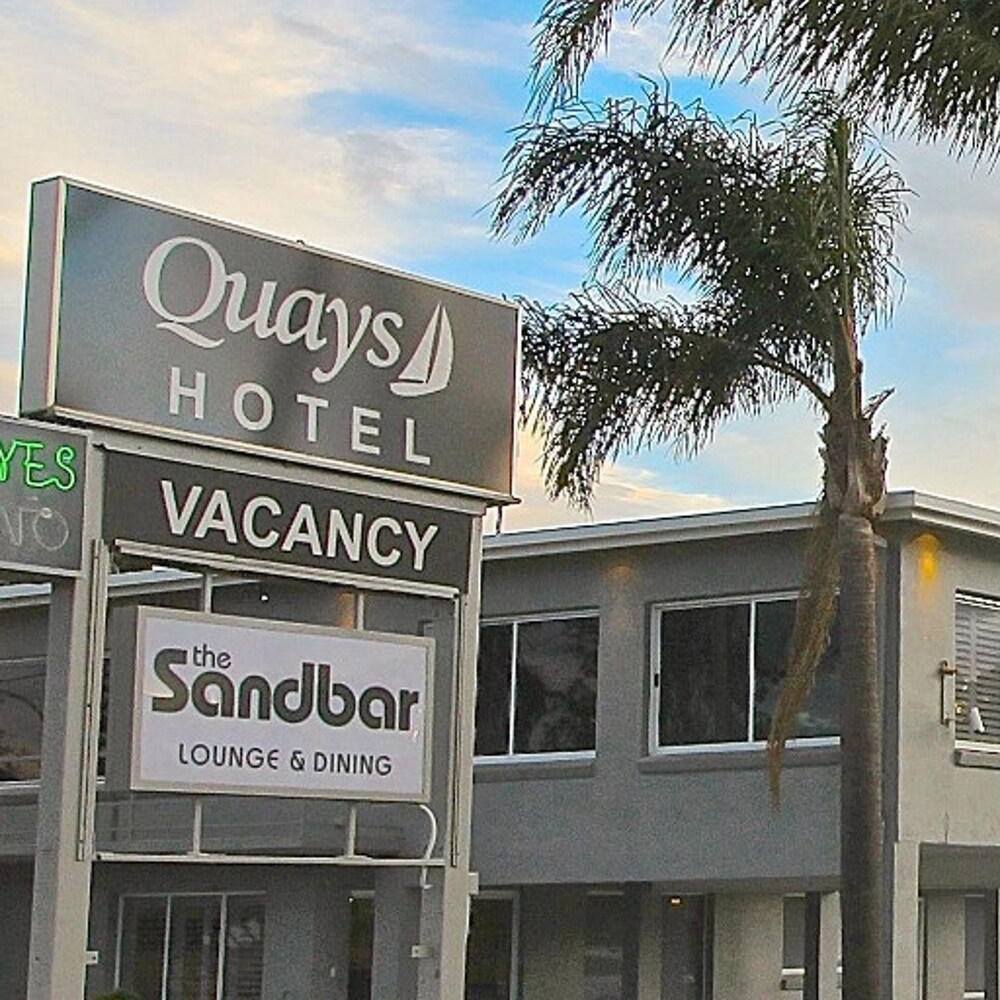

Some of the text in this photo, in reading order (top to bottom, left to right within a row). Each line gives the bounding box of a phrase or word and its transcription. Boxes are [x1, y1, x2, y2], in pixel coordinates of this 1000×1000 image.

[142, 236, 403, 383] Quays
[168, 366, 432, 466] HOTEL
[0, 439, 76, 491] YES
[160, 480, 439, 571] VACANCY
[152, 648, 419, 732] Sandbar
[192, 643, 231, 669] the
[179, 743, 392, 776] LOUNGE & DINING
